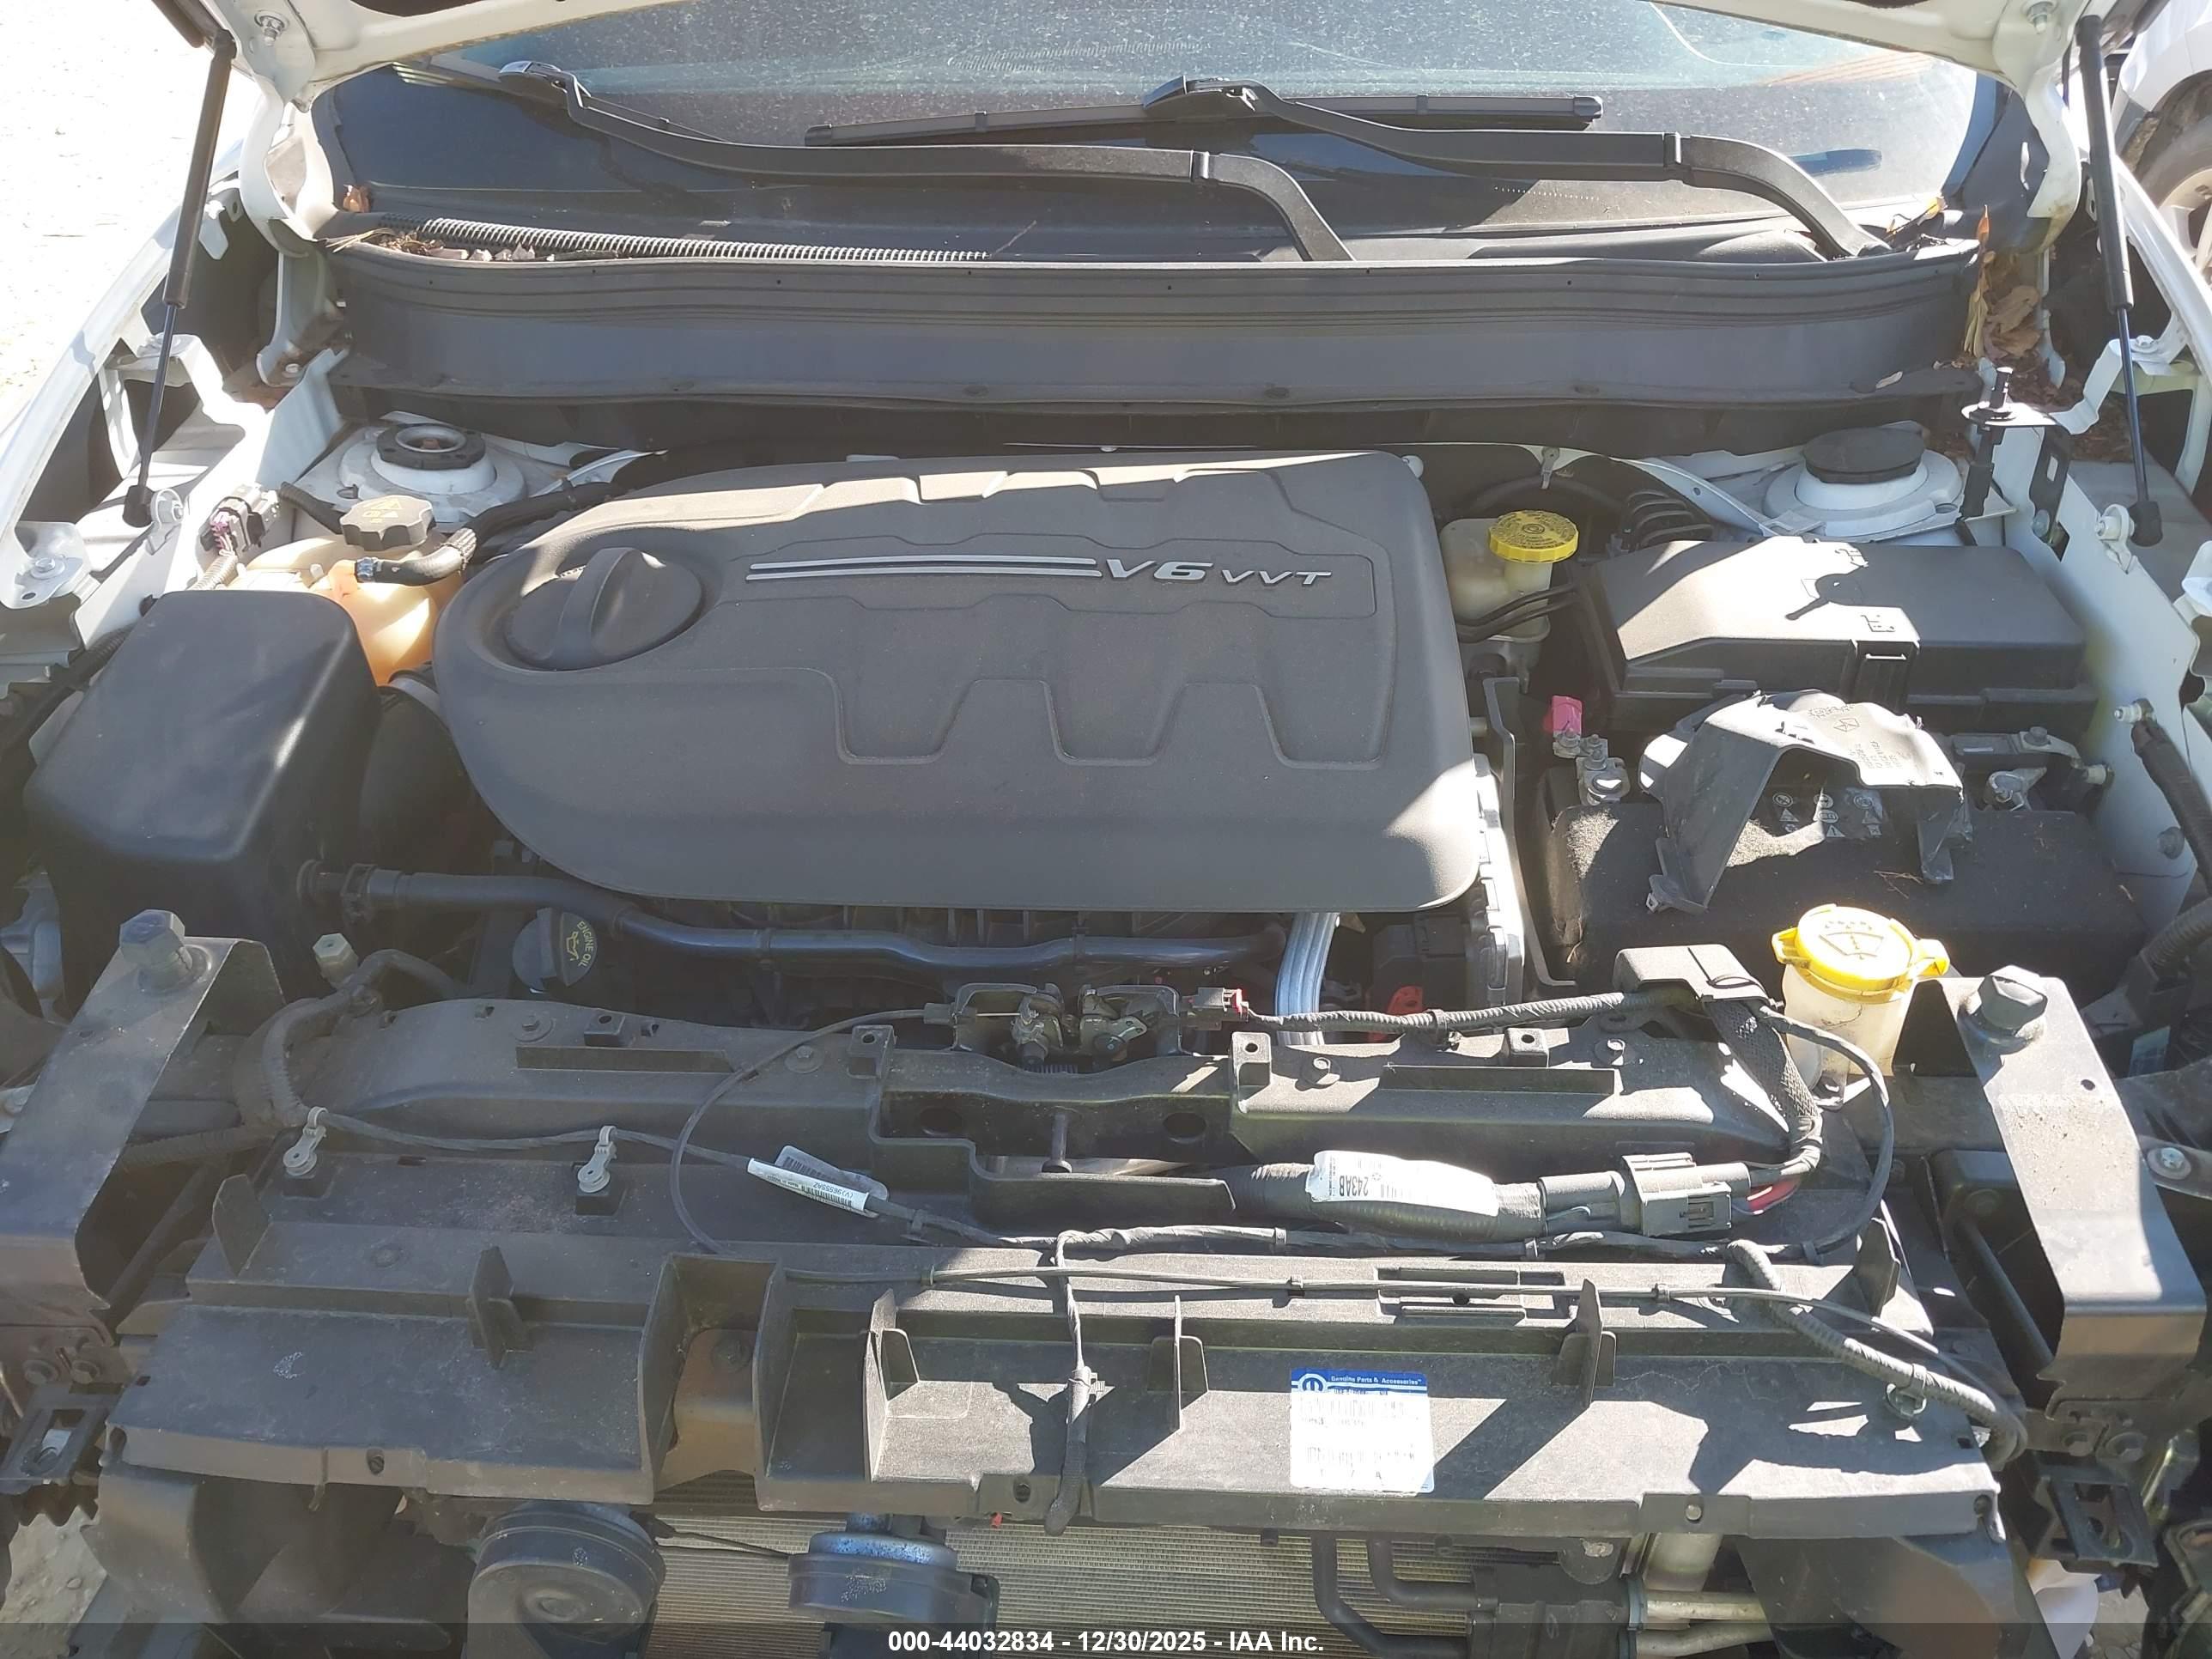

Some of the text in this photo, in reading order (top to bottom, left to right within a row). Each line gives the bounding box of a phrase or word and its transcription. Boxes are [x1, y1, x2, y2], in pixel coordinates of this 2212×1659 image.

[1106, 559, 1332, 586] V6 VVT
[577, 921, 594, 967] ENGINE OIL
